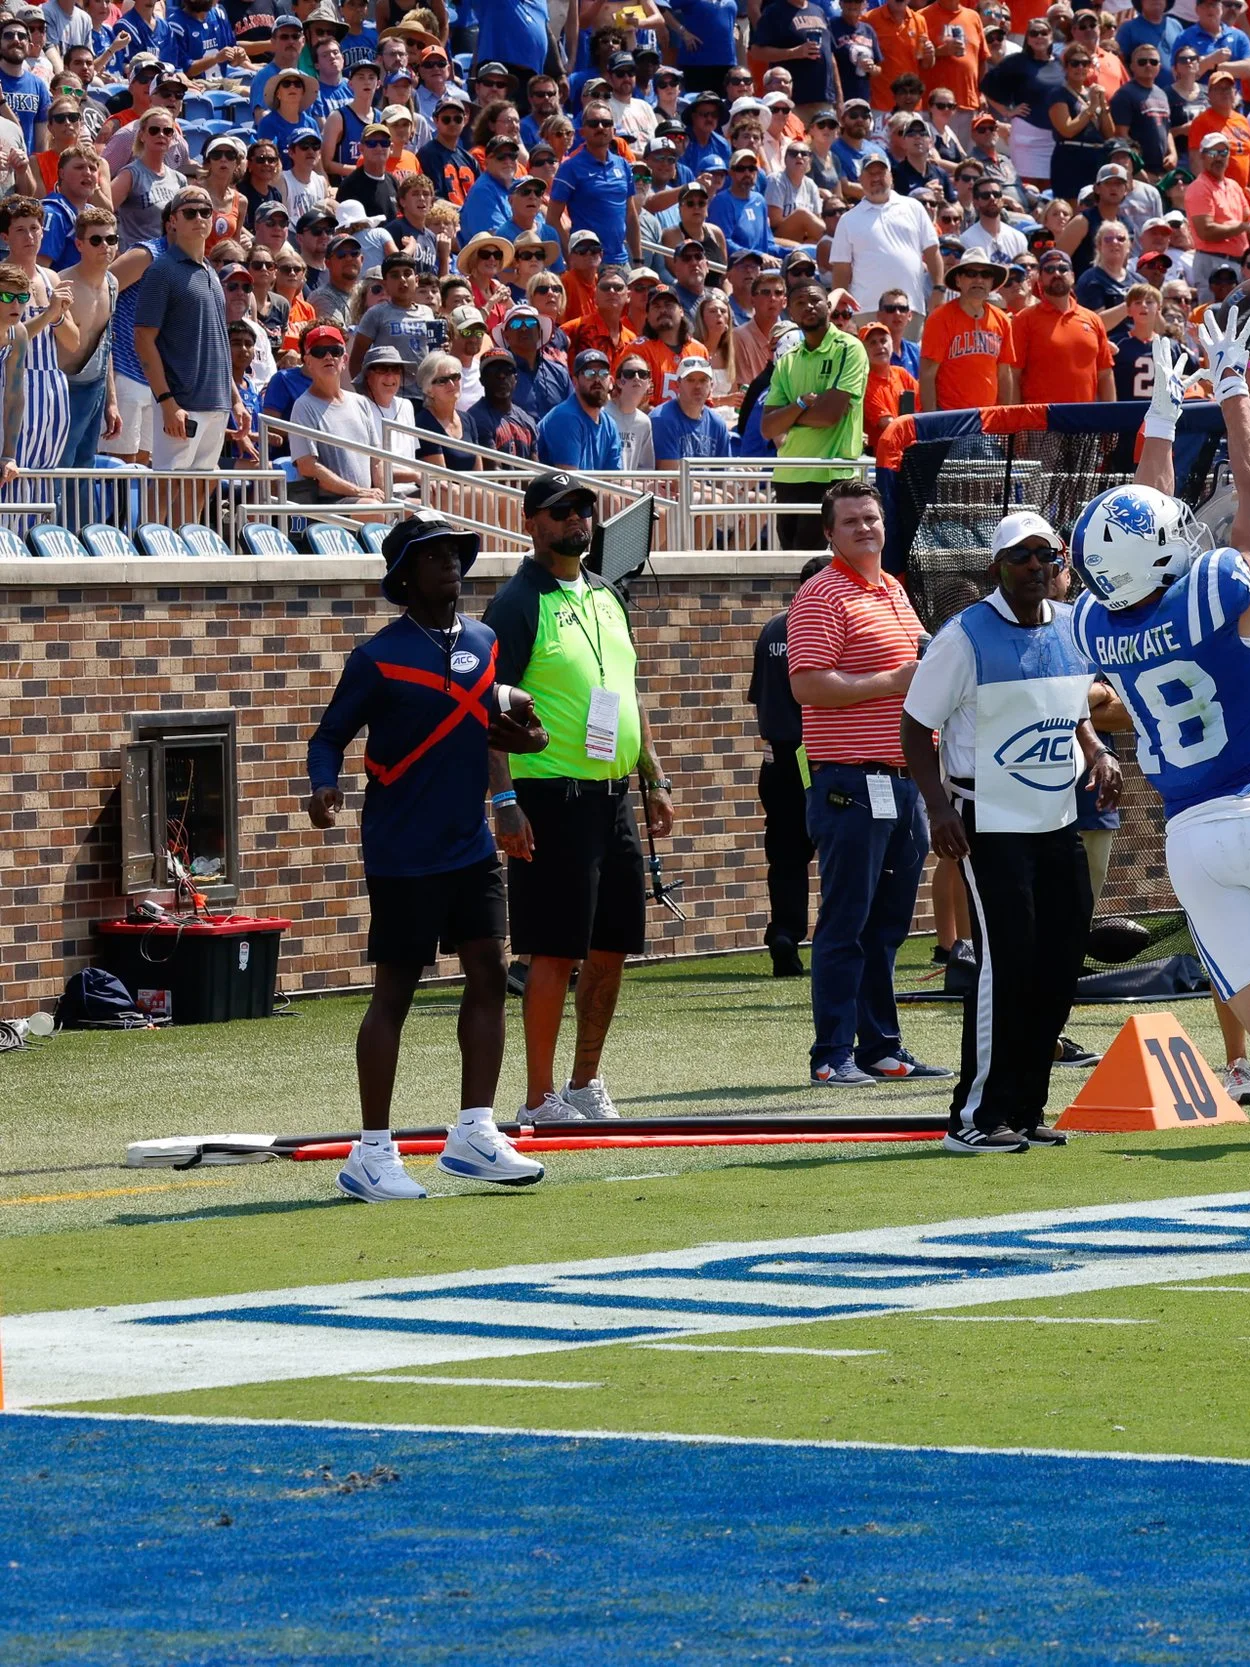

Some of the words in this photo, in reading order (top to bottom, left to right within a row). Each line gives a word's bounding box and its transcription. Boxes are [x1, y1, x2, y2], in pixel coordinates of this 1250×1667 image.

[452, 655, 473, 666] ACC
[1095, 620, 1182, 666] BARKATE
[1102, 659, 1229, 775] 18
[1016, 736, 1074, 763] AC
[1144, 1036, 1218, 1121] 10
